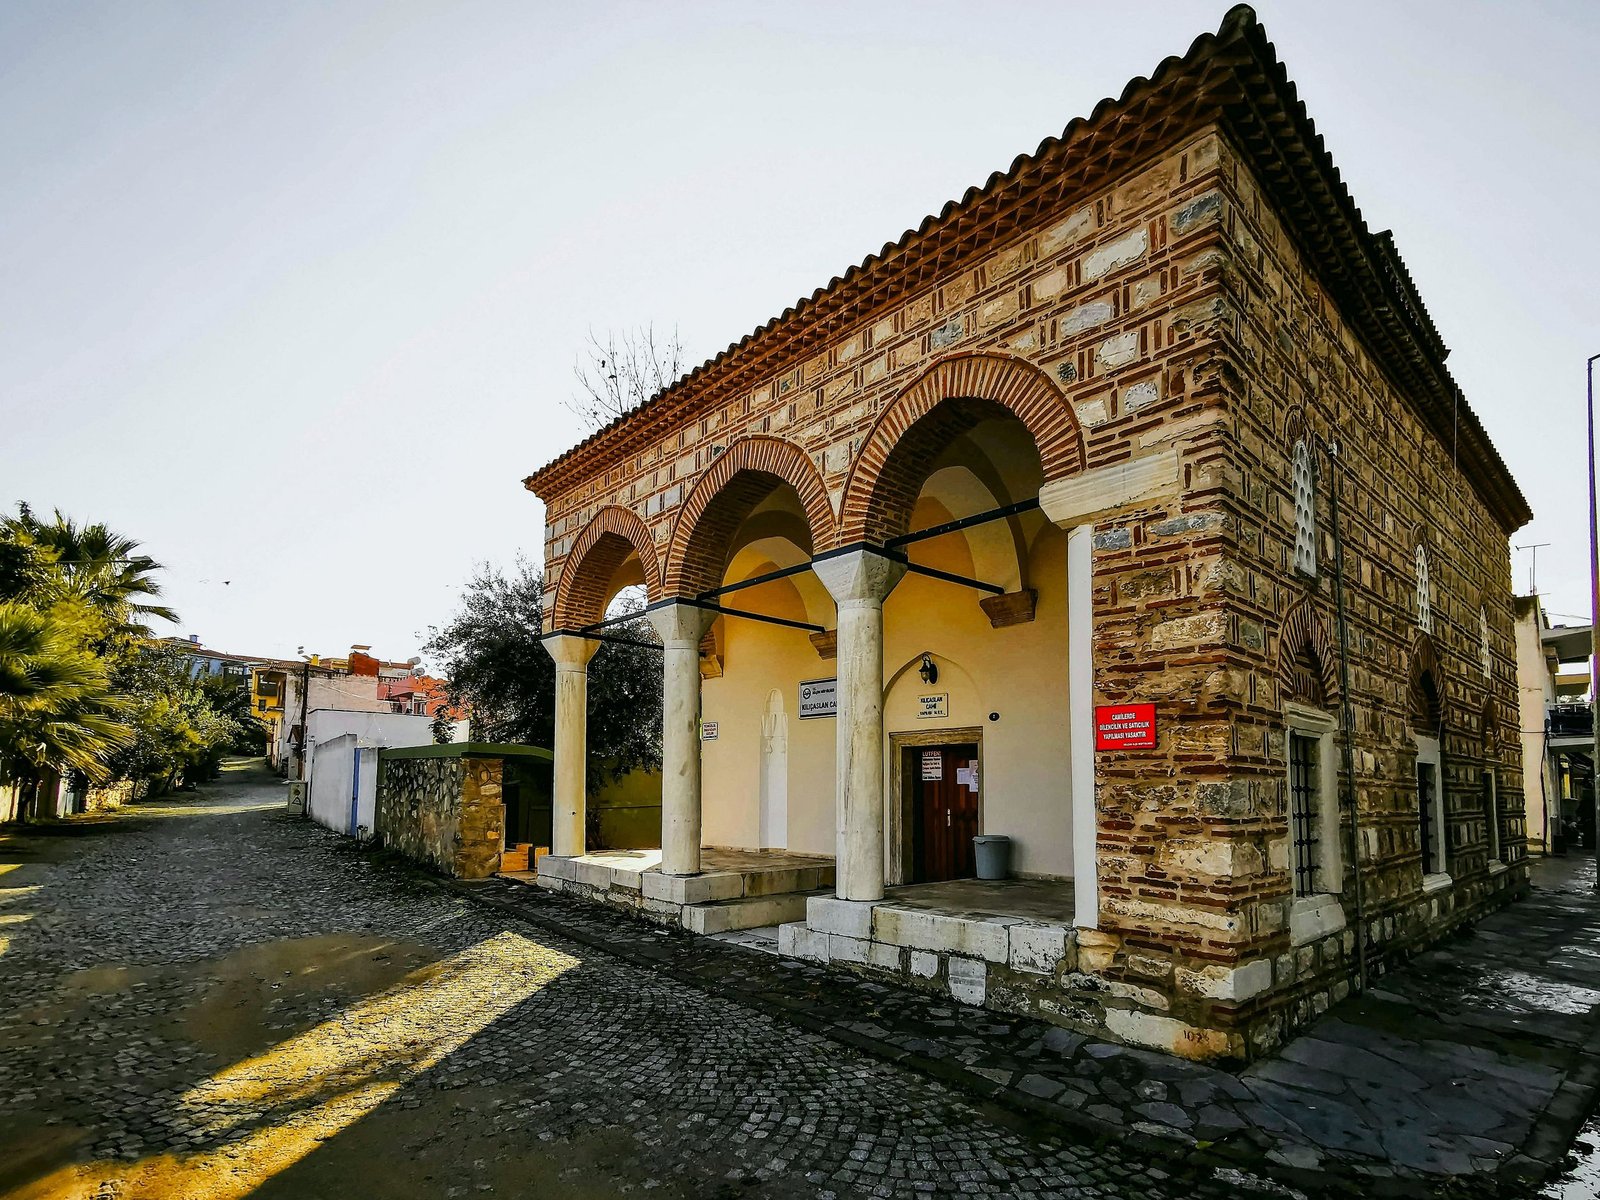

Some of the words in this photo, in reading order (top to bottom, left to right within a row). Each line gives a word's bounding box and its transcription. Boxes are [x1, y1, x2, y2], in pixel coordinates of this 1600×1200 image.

[1129, 721, 1150, 729] SATICILIK
[1103, 732, 1125, 740] YAPILMASI
[1125, 731, 1146, 739] YASAKTIR
